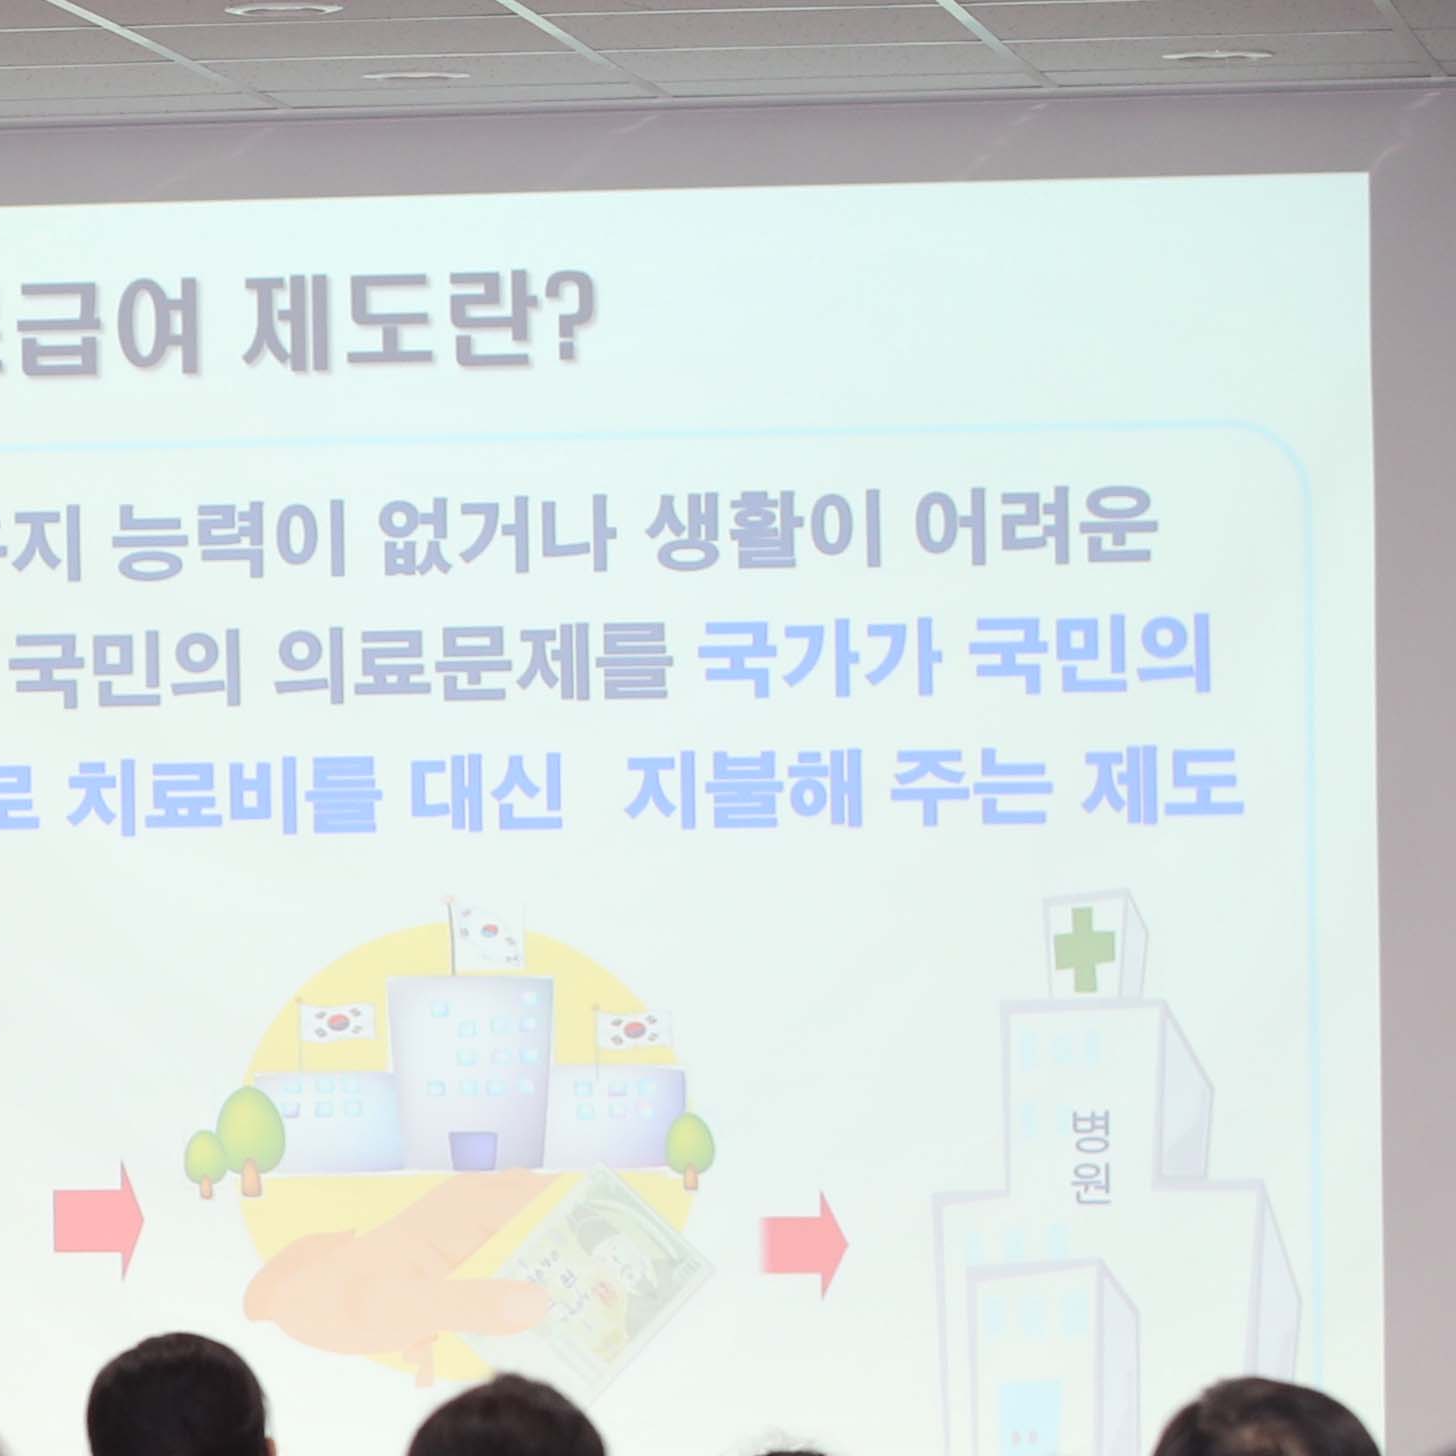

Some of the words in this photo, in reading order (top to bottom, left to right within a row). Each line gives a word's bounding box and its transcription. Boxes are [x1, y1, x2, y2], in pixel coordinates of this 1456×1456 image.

[242, 267, 599, 375] 제도란?
[111, 498, 346, 583] 능력이
[378, 493, 618, 577] 없거나
[644, 488, 883, 573] 생활이
[914, 484, 1160, 567] 어려운
[7, 627, 243, 710] 국민의
[273, 621, 674, 706] 의료문제를
[696, 615, 944, 700] 국가가
[968, 611, 1213, 696] 국민의
[65, 754, 384, 838] 치료비를
[410, 752, 564, 833] 대신
[622, 746, 864, 831] 지불해
[889, 746, 1055, 828] 주는
[1080, 743, 1246, 826] 제도
[1070, 1108, 1113, 1206] 병원
